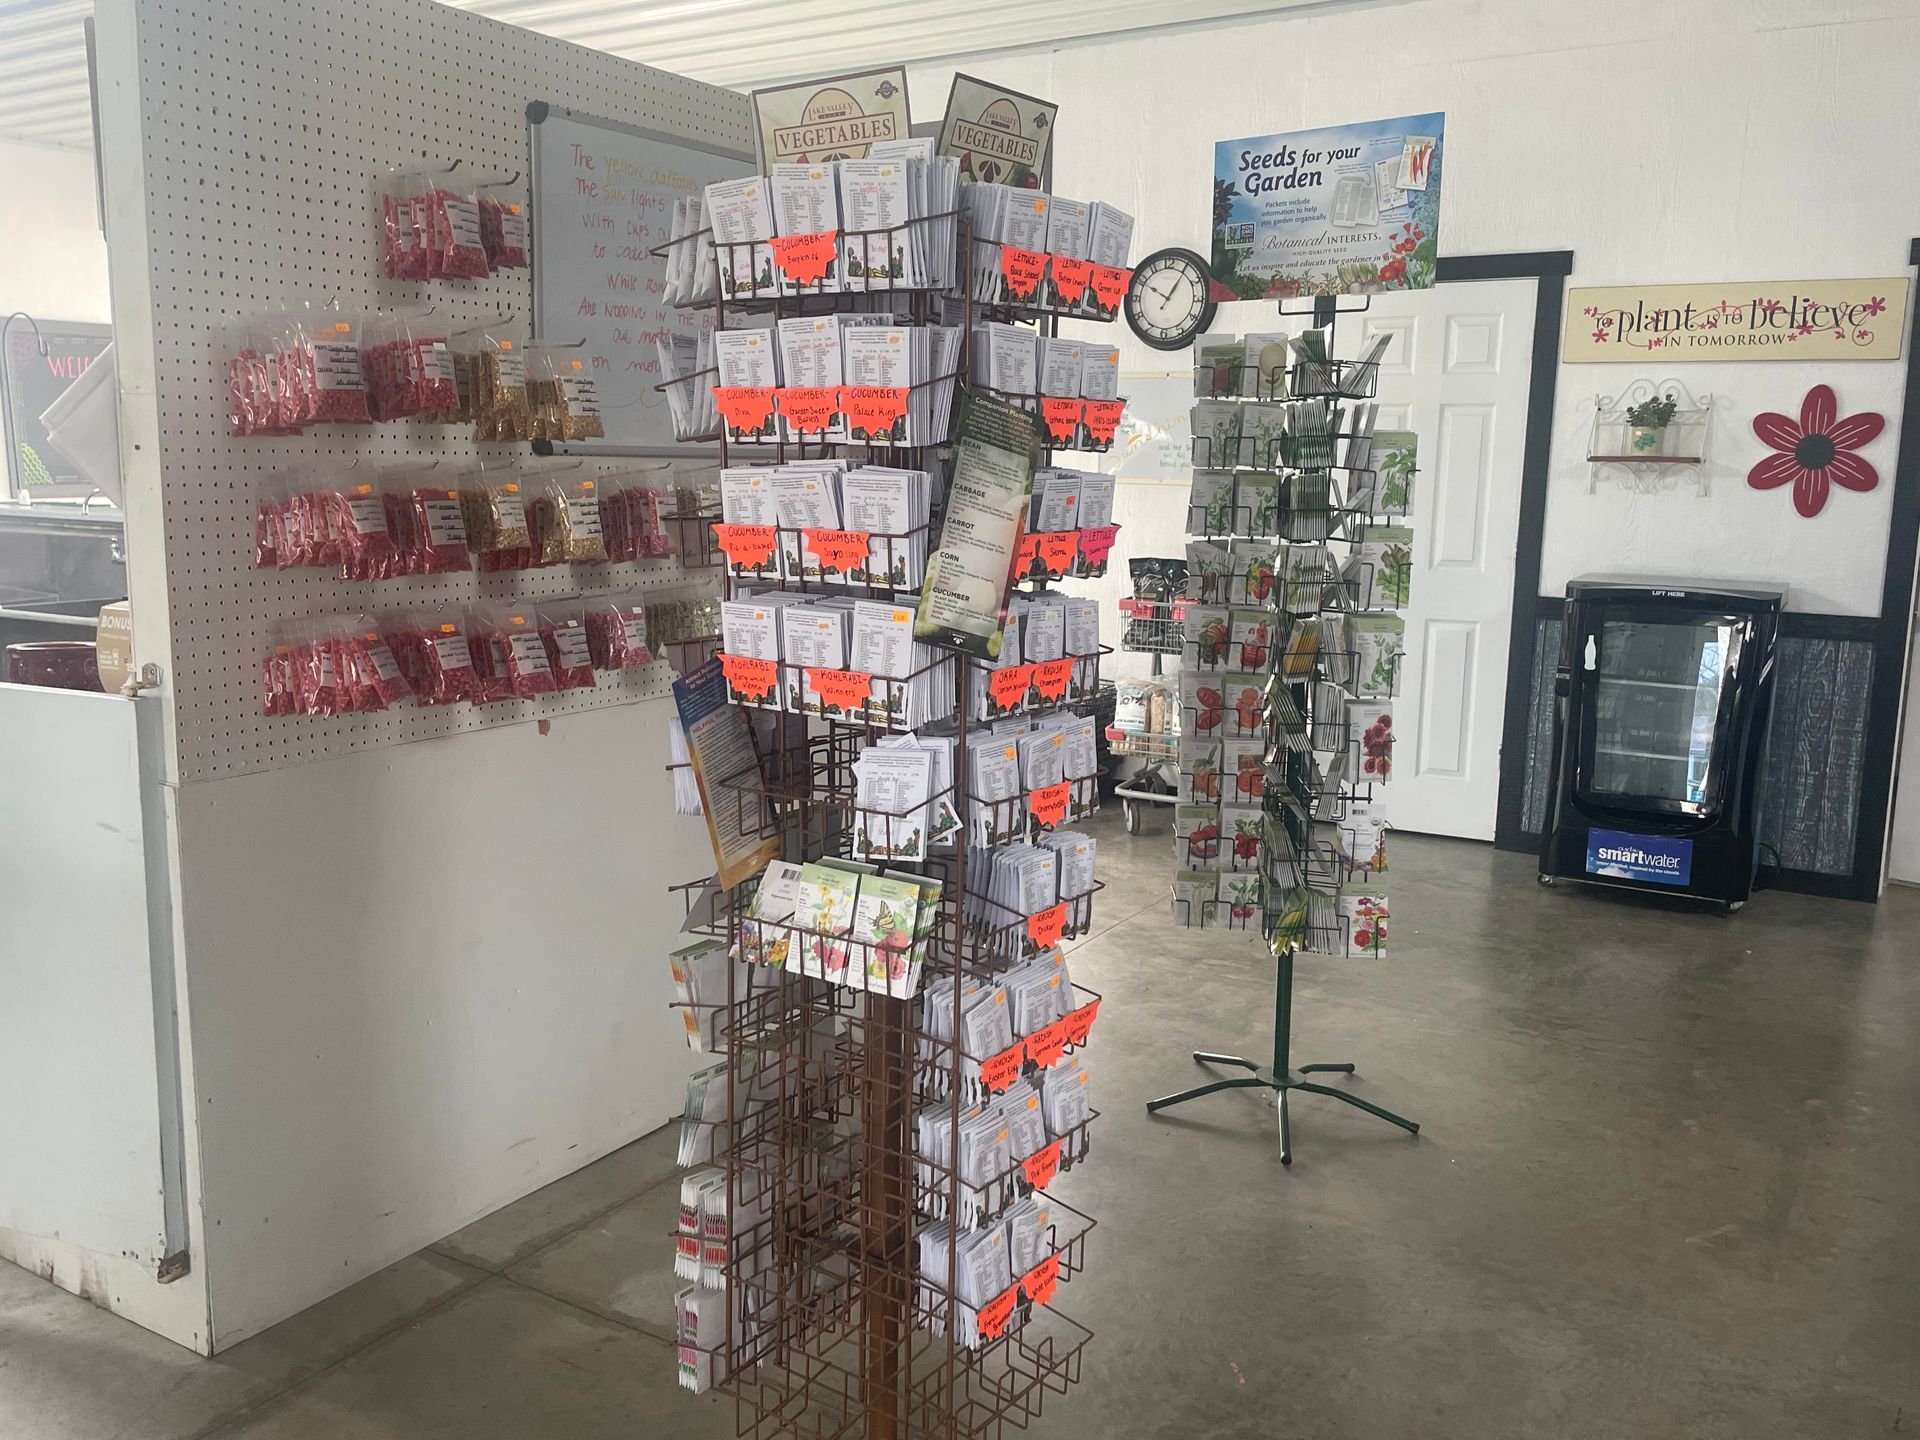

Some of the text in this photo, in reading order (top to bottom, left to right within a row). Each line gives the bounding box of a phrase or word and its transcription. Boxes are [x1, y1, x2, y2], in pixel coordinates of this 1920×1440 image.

[778, 118, 892, 150] VEGETABLES
[956, 125, 1036, 160] VEGETABLES
[570, 144, 595, 169] The
[1239, 145, 1361, 171] Seeds for your
[1245, 169, 1322, 197] Garden
[575, 177, 598, 198] The
[631, 188, 665, 220] lights
[1265, 197, 1311, 209] Packets include
[1261, 206, 1296, 217] information
[1304, 205, 1318, 215] help
[1261, 213, 1327, 228] you garden organically
[1262, 230, 1327, 251] Botanical
[1292, 248, 1331, 257] HIGH-QUALITY
[1239, 264, 1249, 273] Let
[1261, 261, 1284, 272] inspire
[1285, 259, 1298, 270] and
[1299, 257, 1327, 268] educate
[1328, 256, 1339, 266] the
[1340, 254, 1373, 267] gardener
[678, 313, 694, 326] THE
[1616, 298, 1697, 343] plant
[1750, 295, 1868, 331] believe
[1664, 332, 1786, 348] IN TOMORROW
[878, 405, 897, 421] King
[975, 396, 1033, 424] Companion Planting
[962, 439, 981, 451] BEAN
[954, 482, 986, 498] CABBAGE
[946, 516, 975, 530] CARROT
[940, 551, 960, 562] CORN
[932, 586, 970, 602] CUCUMBER
[1651, 589, 1686, 599] LIFT HERE
[101, 615, 131, 631] BONUS
[1598, 847, 1681, 869] smartwater
